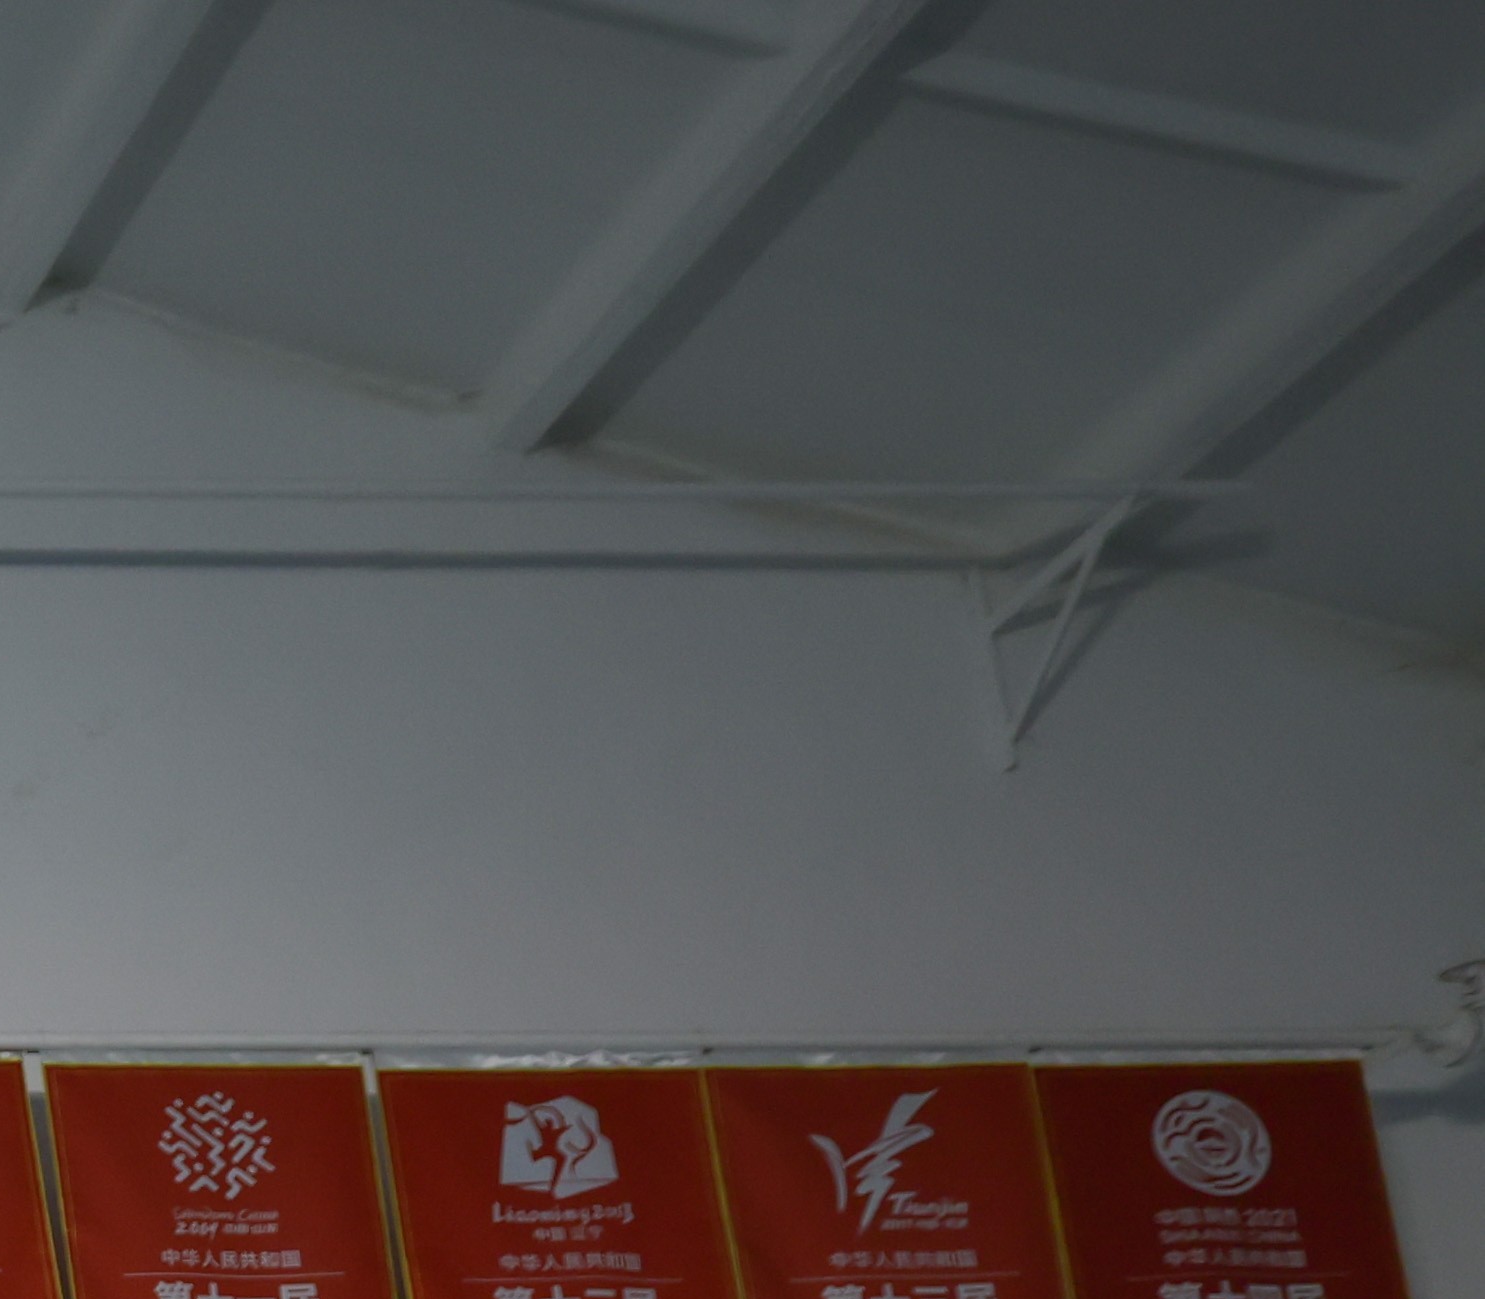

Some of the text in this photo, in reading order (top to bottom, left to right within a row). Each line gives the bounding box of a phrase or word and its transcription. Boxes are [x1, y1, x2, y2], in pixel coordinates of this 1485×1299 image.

[161, 1249, 302, 1269] 中华人民共和国
